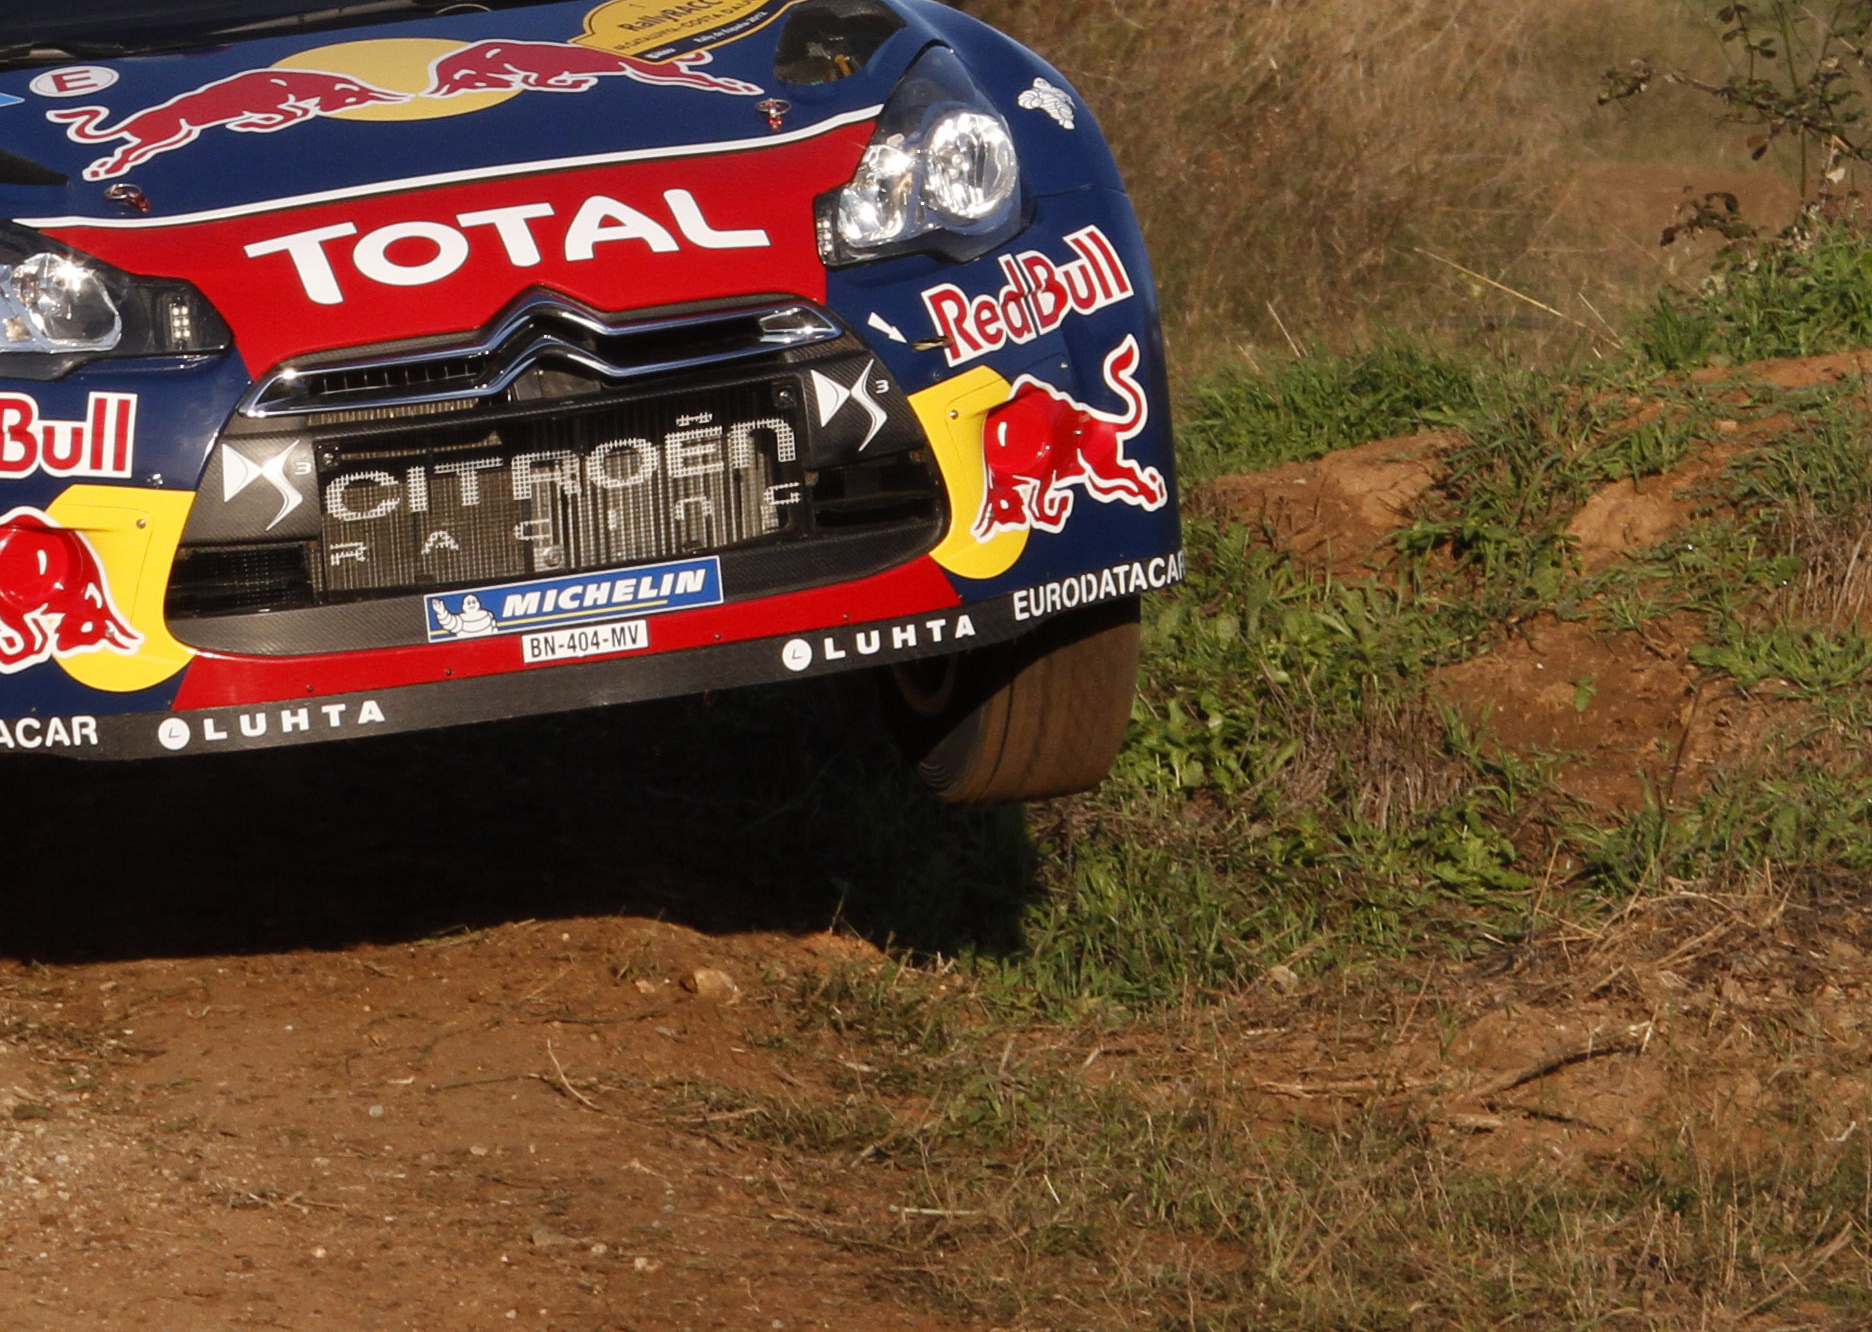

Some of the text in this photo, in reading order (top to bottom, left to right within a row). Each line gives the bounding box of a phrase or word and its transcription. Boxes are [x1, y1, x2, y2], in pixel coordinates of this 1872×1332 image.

[51, 69, 99, 93] E
[243, 188, 771, 306] TOTAL
[502, 568, 706, 618] MICHELIN
[824, 614, 976, 661] LUHTA
[1012, 549, 1186, 622] EURODATACAR
[530, 625, 639, 659] BN-404-MV
[203, 700, 385, 741] LUHTA
